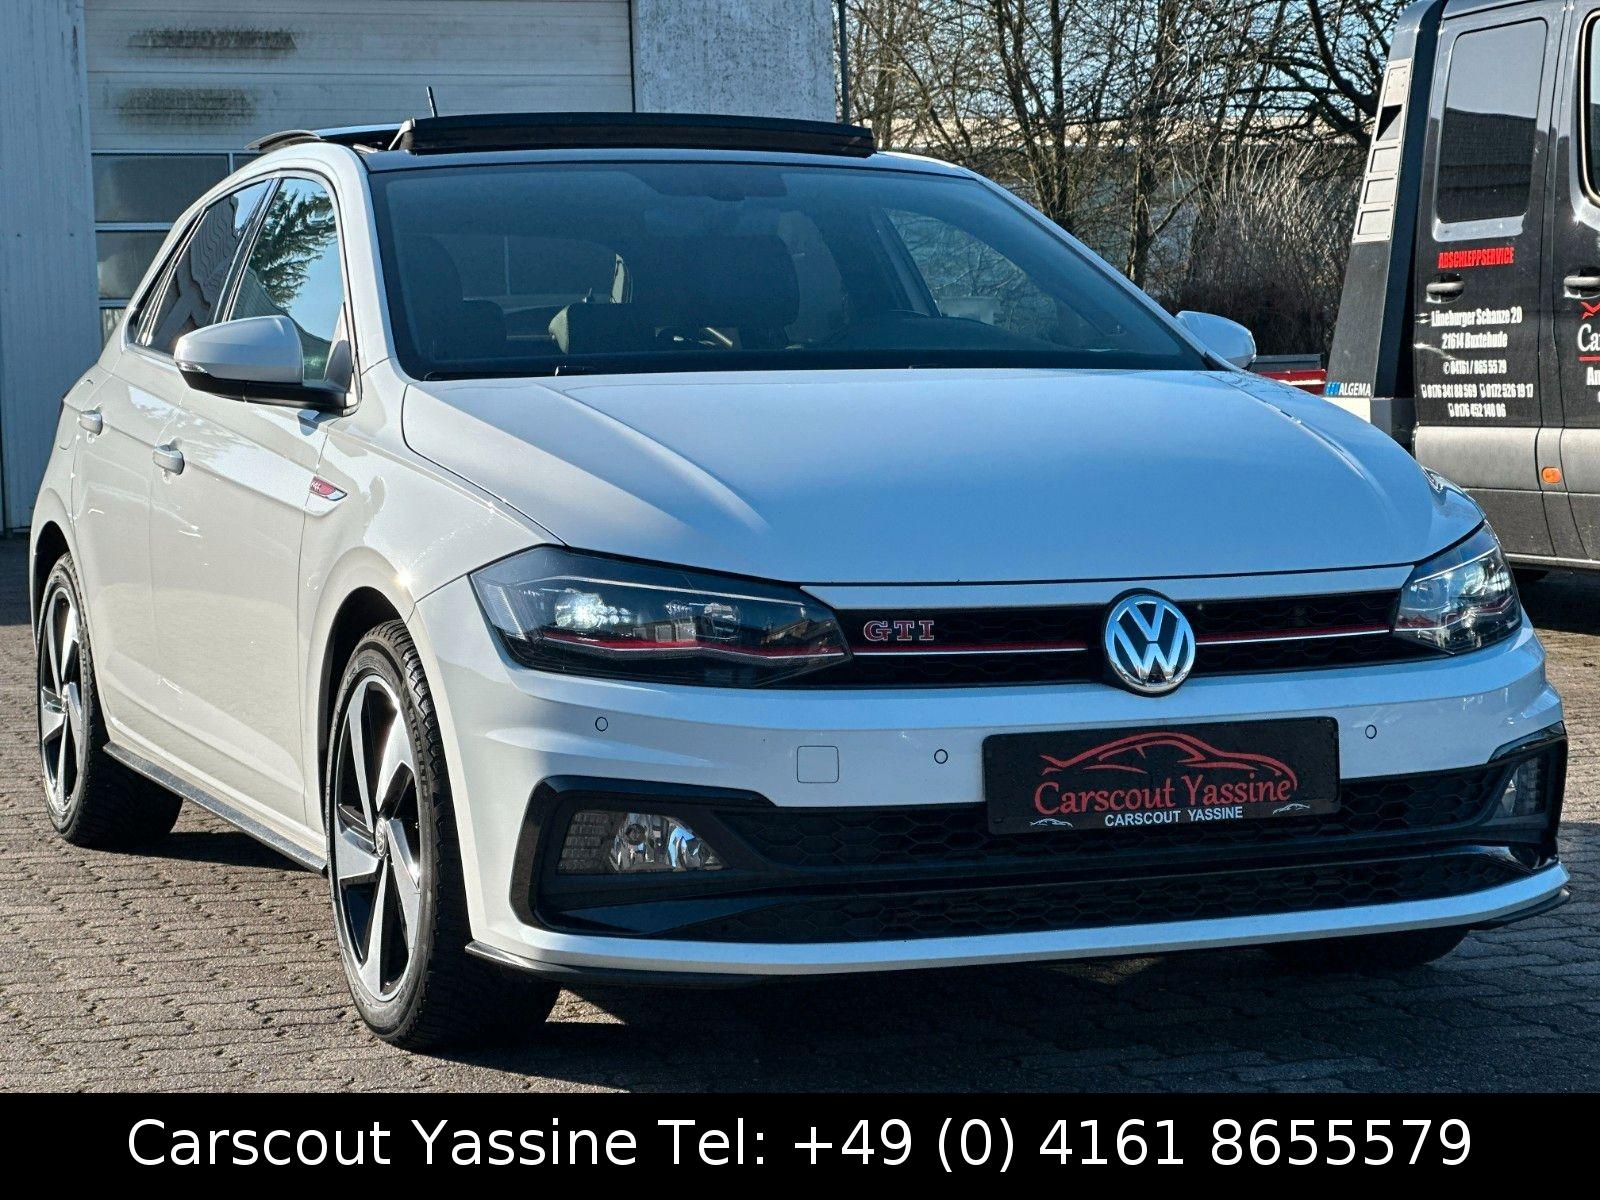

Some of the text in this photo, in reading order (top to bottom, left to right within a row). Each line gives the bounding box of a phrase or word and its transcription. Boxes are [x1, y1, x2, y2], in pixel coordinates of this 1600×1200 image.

[1438, 247, 1515, 269] ABSCHLEPPSERVICE
[1476, 308, 1511, 325] Schanze
[1511, 306, 1523, 324] 20
[1442, 331, 1508, 349] 21614 Buxtehude
[1577, 323, 1600, 352] Ca
[1339, 382, 1371, 396] ALGEMA
[863, 620, 935, 641] GTI
[1034, 773, 1292, 816] Carscout Yassine
[1104, 806, 1243, 828] CARSCOUT YASSINE
